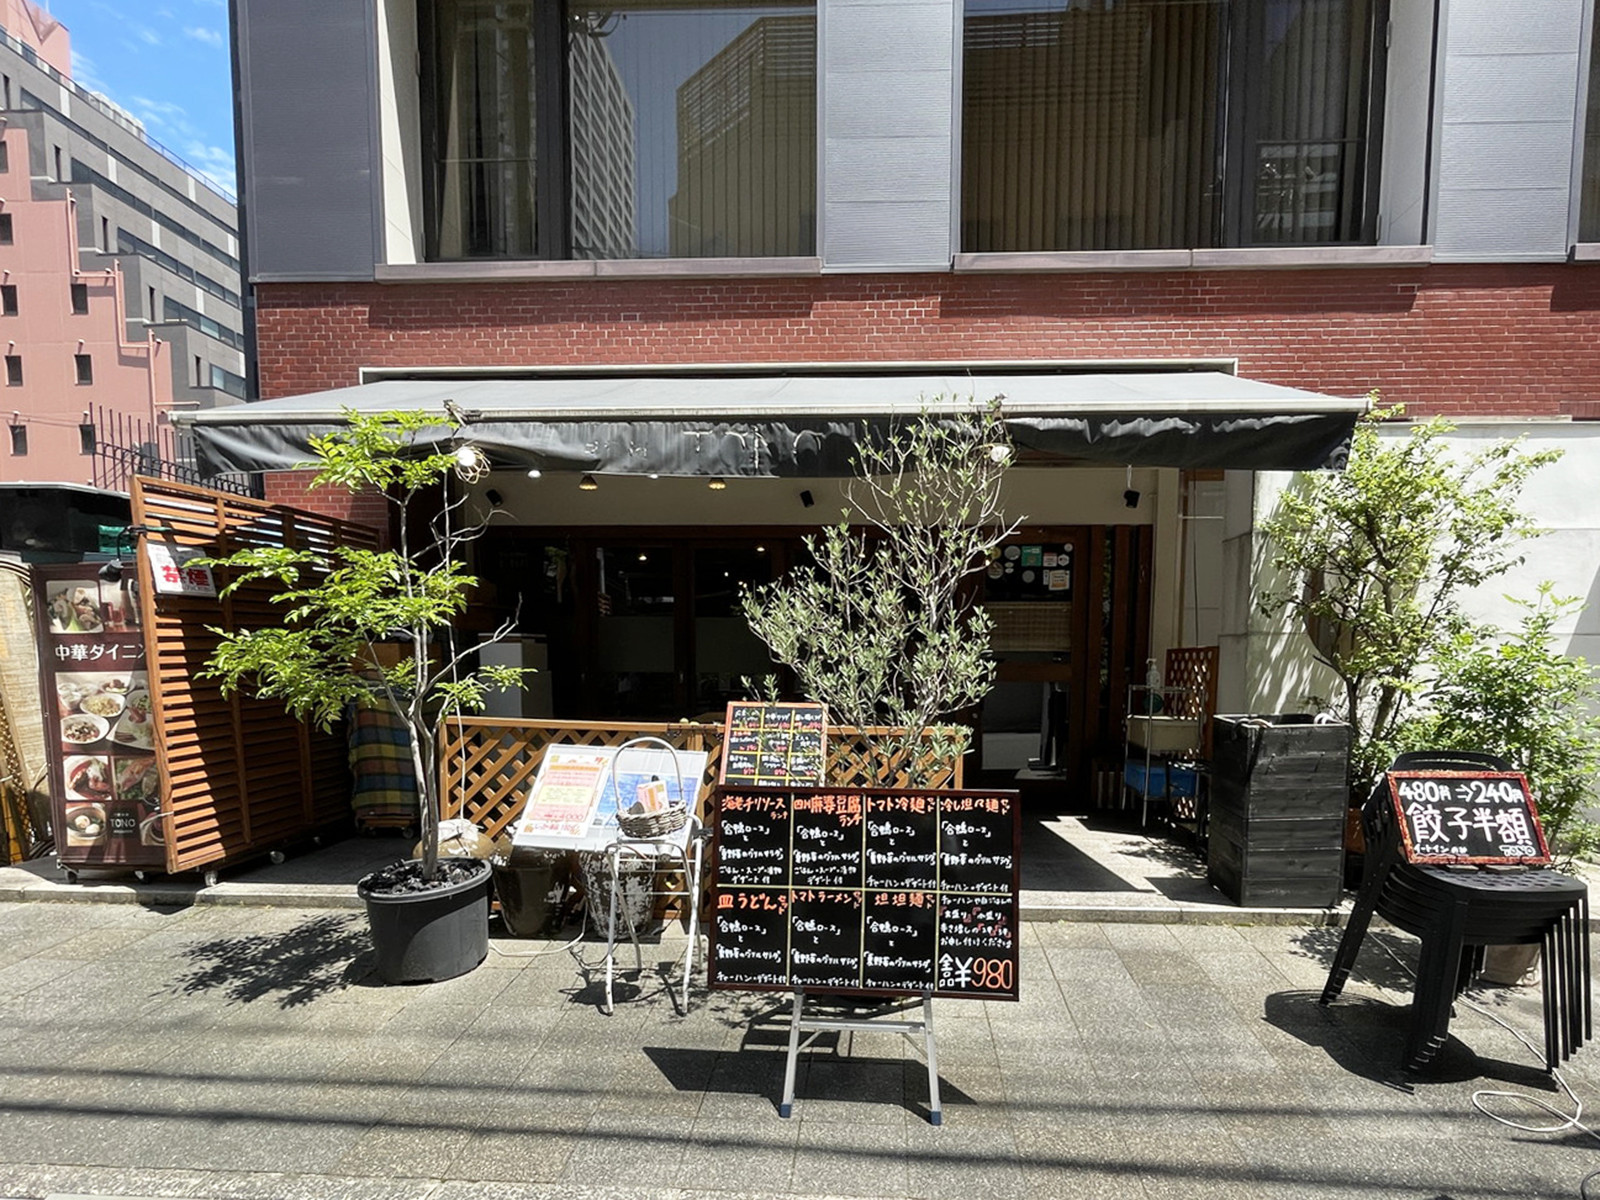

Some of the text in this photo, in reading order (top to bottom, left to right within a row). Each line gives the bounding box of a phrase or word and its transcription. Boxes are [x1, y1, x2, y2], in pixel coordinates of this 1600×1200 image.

[1399, 781, 1525, 803] 480円 240円
[721, 795, 786, 812] 海老チリソース
[793, 795, 862, 815] 四川麻婆豆腐
[110, 818, 136, 828] TONO
[839, 813, 862, 827] ランチ
[1406, 802, 1532, 845] 餃子半額
[717, 893, 777, 910] 皿うどん
[791, 890, 852, 903] トマトラーメン
[955, 956, 1013, 989] ¥980
